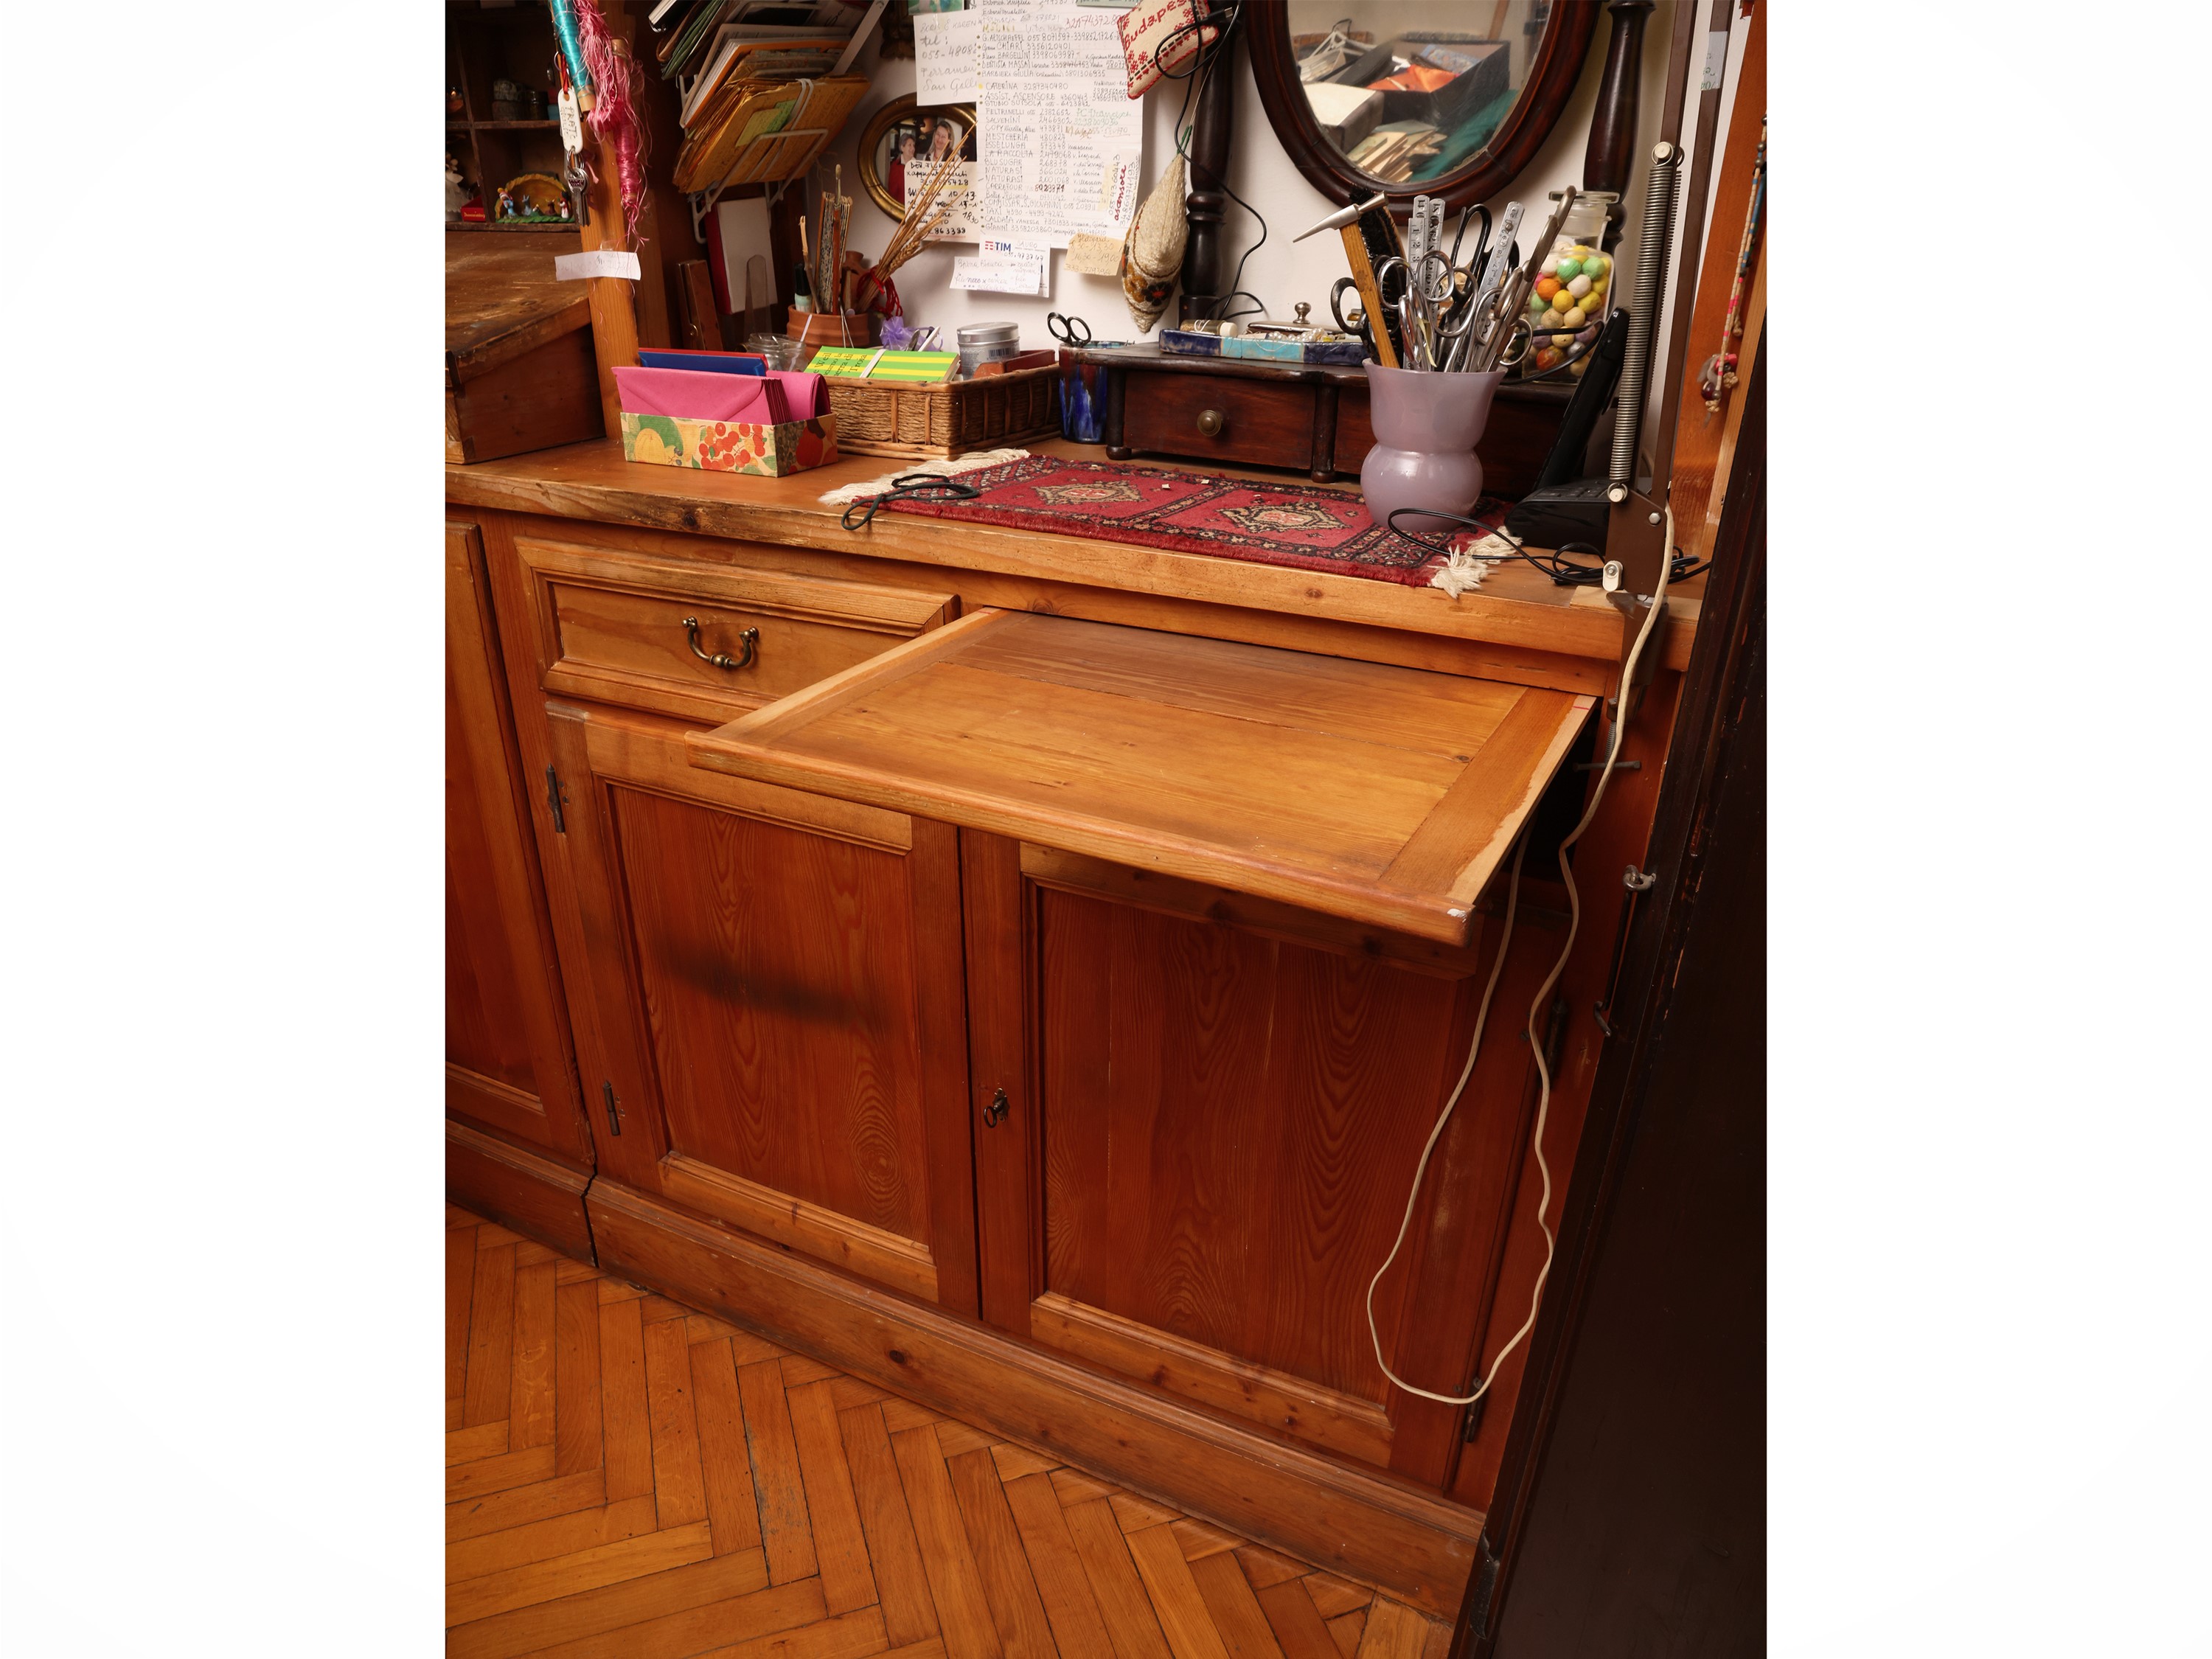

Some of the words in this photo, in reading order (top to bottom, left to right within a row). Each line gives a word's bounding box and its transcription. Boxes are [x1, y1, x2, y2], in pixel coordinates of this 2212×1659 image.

[1124, 0, 1190, 51] Budapes
[985, 140, 1026, 149] ESSELUNGA
[995, 242, 1011, 251] TIM
[815, 352, 832, 368] Weil
[848, 354, 868, 373] Troia
